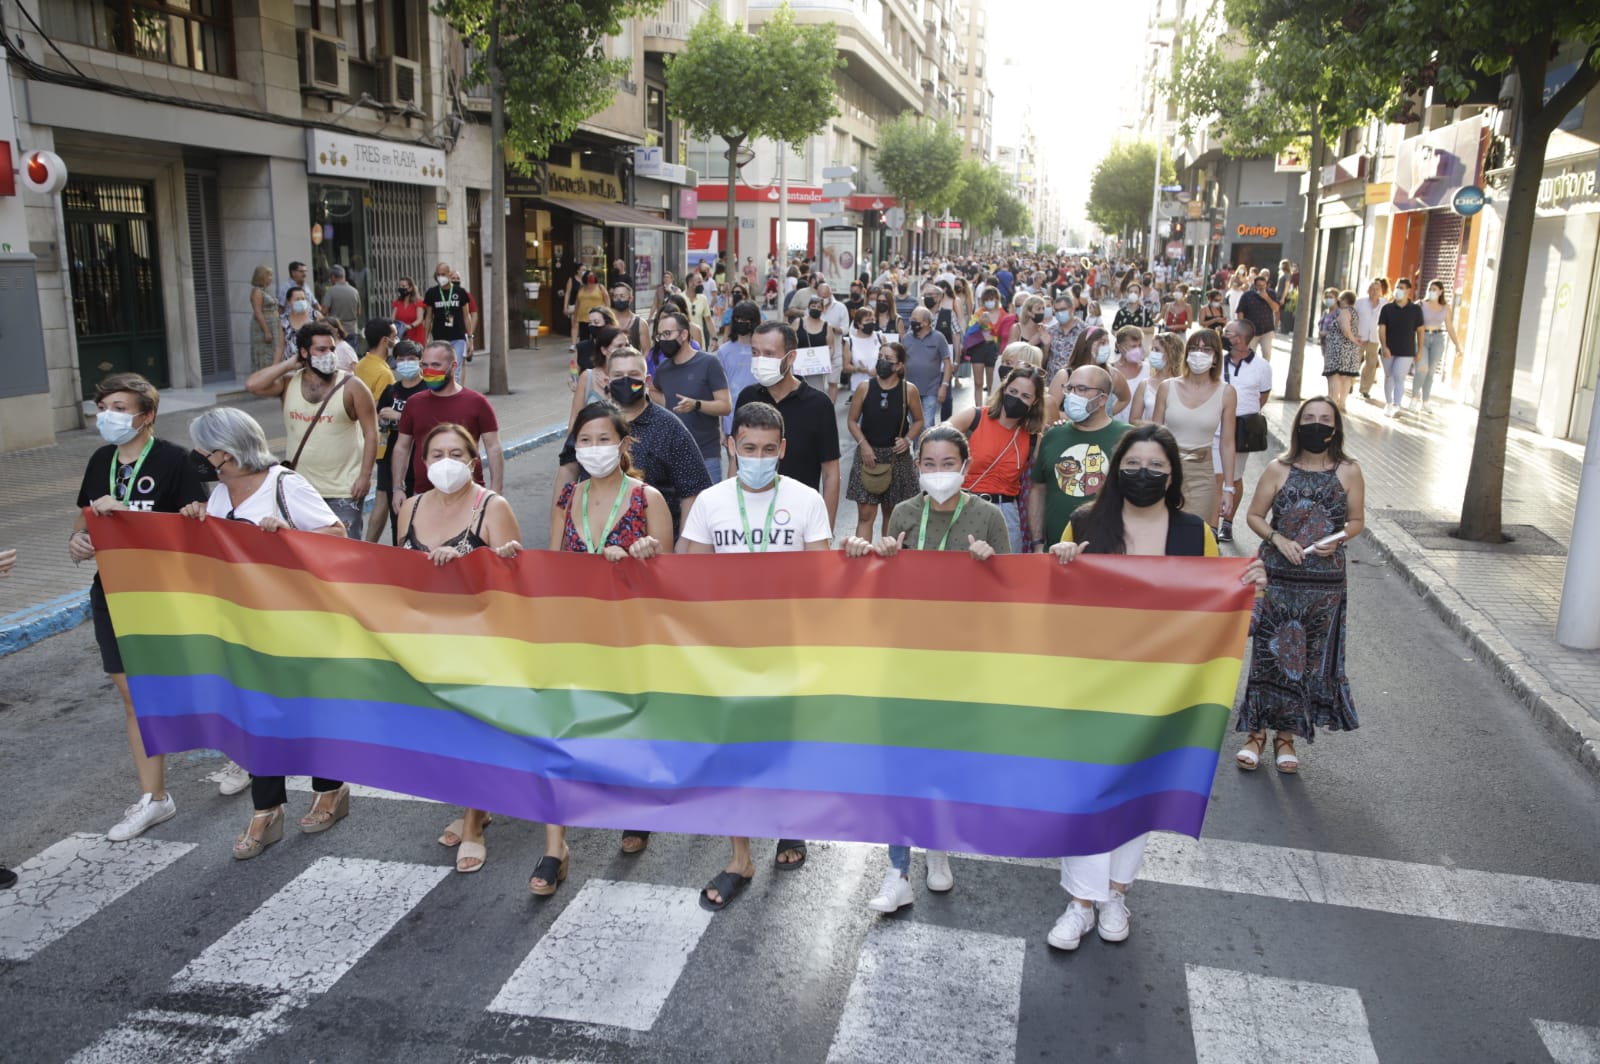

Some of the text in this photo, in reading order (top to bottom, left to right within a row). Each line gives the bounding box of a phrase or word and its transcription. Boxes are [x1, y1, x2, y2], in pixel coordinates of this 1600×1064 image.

[354, 144, 380, 163] TRES
[392, 149, 417, 169] RAYA
[787, 190, 822, 201] antander
[1237, 224, 1277, 238] Orange
[714, 528, 795, 546] DIMOVE
